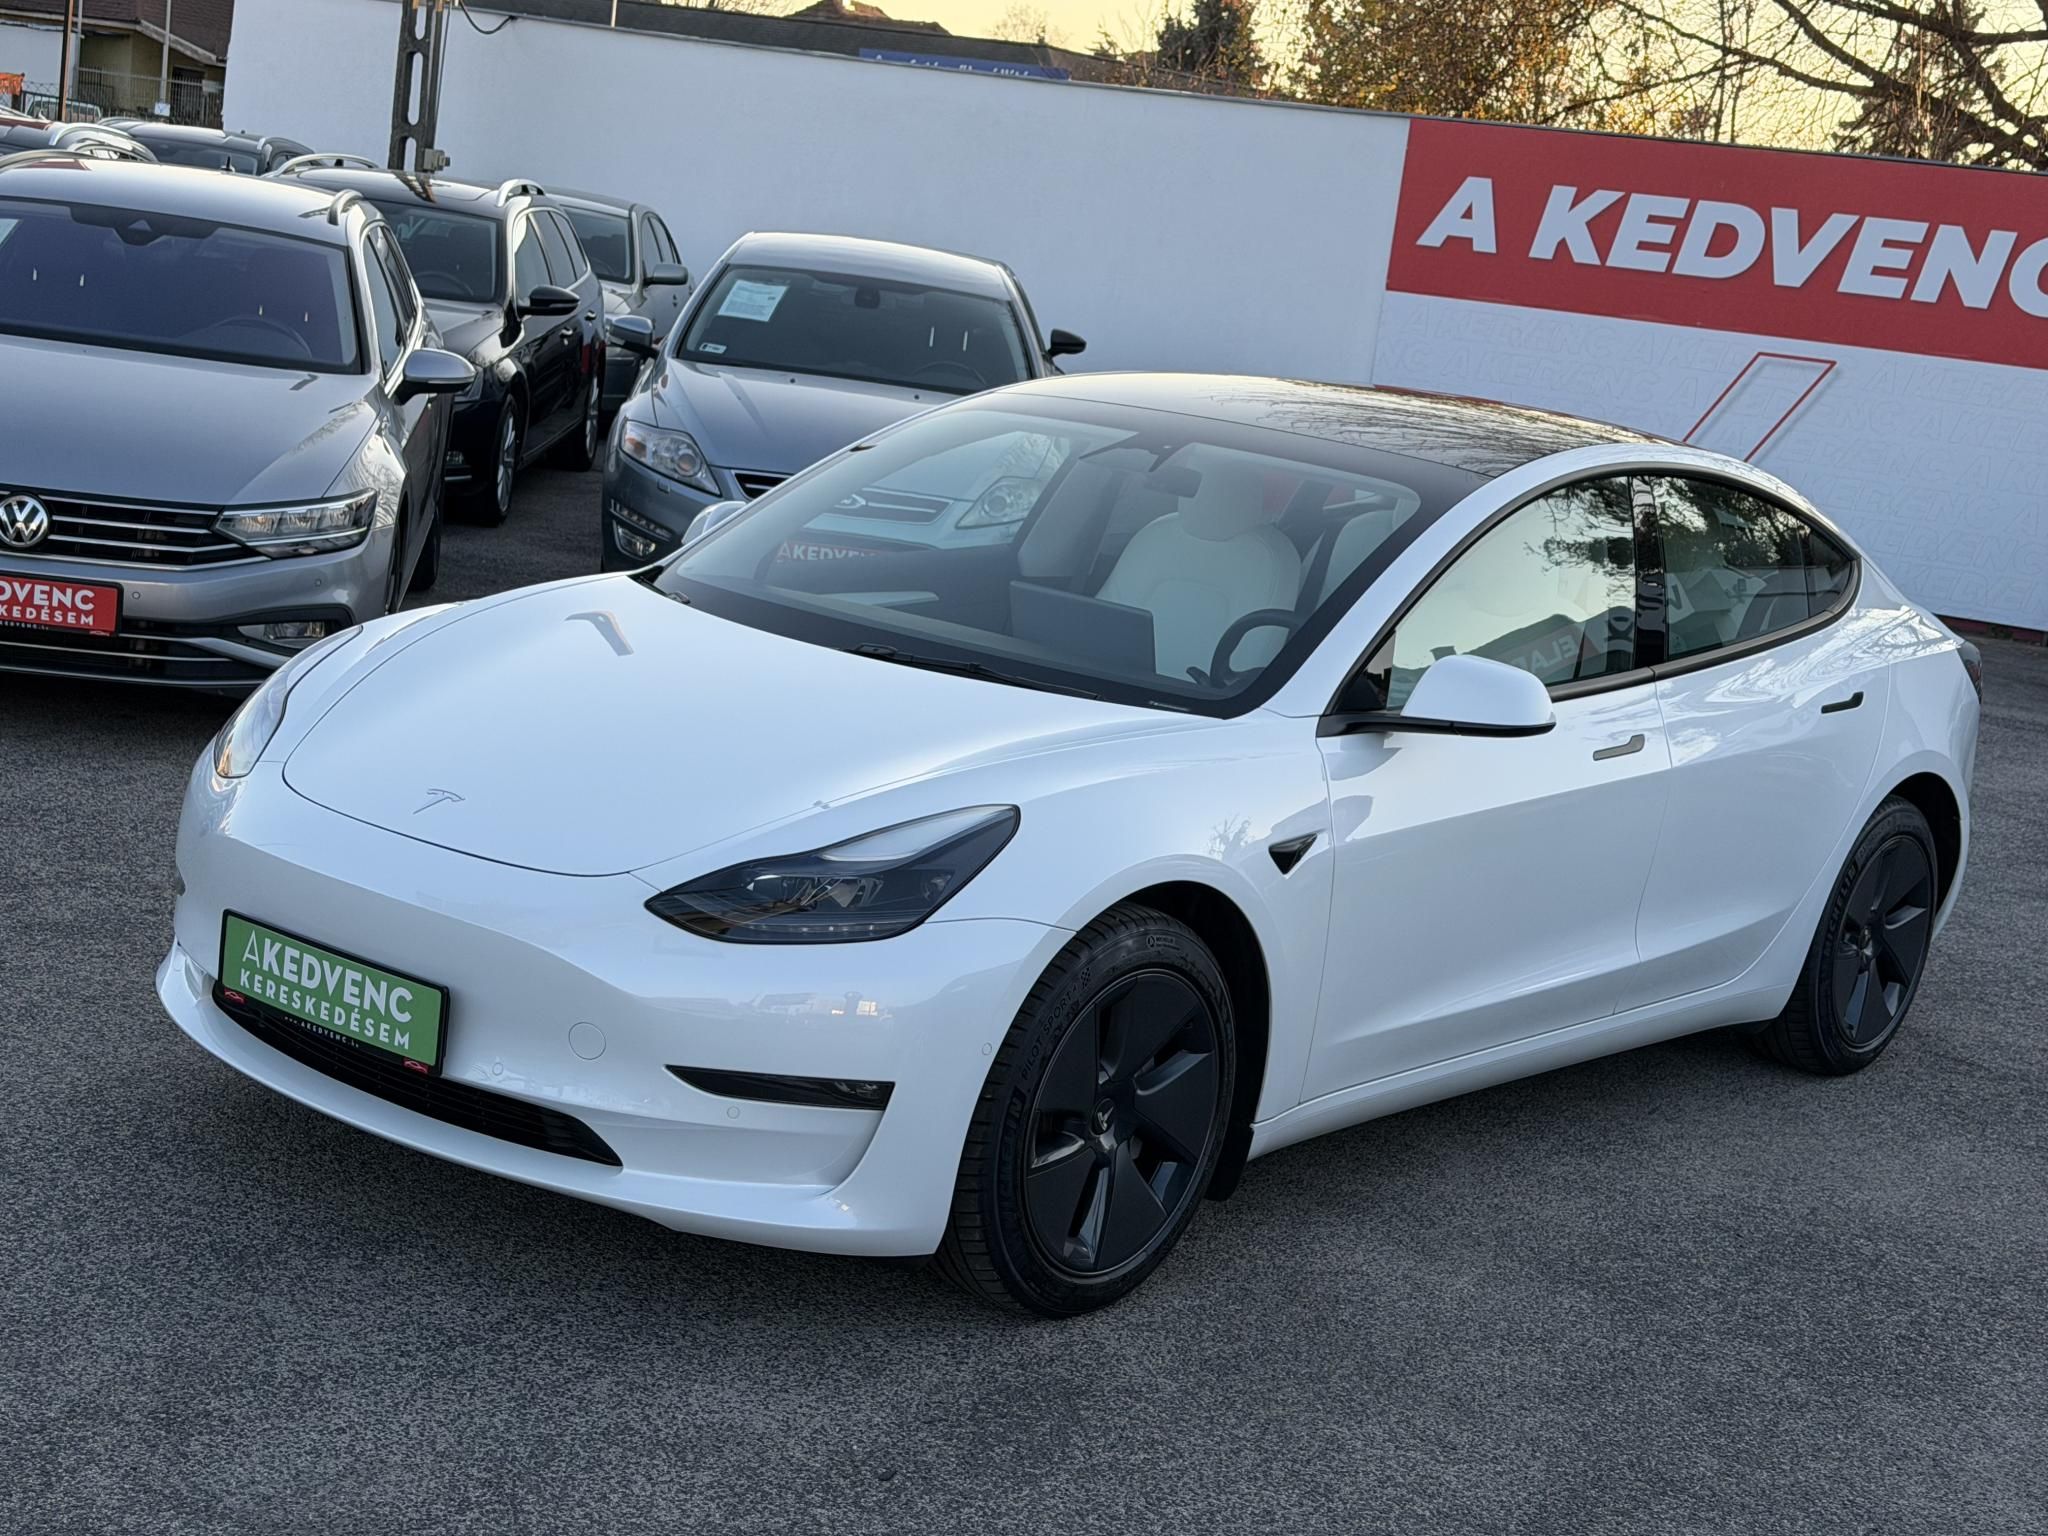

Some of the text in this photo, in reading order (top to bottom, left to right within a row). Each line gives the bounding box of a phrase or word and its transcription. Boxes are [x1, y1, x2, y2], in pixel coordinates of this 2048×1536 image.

[1416, 176, 1497, 254] A
[776, 539, 877, 561] AKEDV
[239, 967, 410, 1050] KERESKEDÉSEM
[1041, 989, 1072, 1032] SPORT
